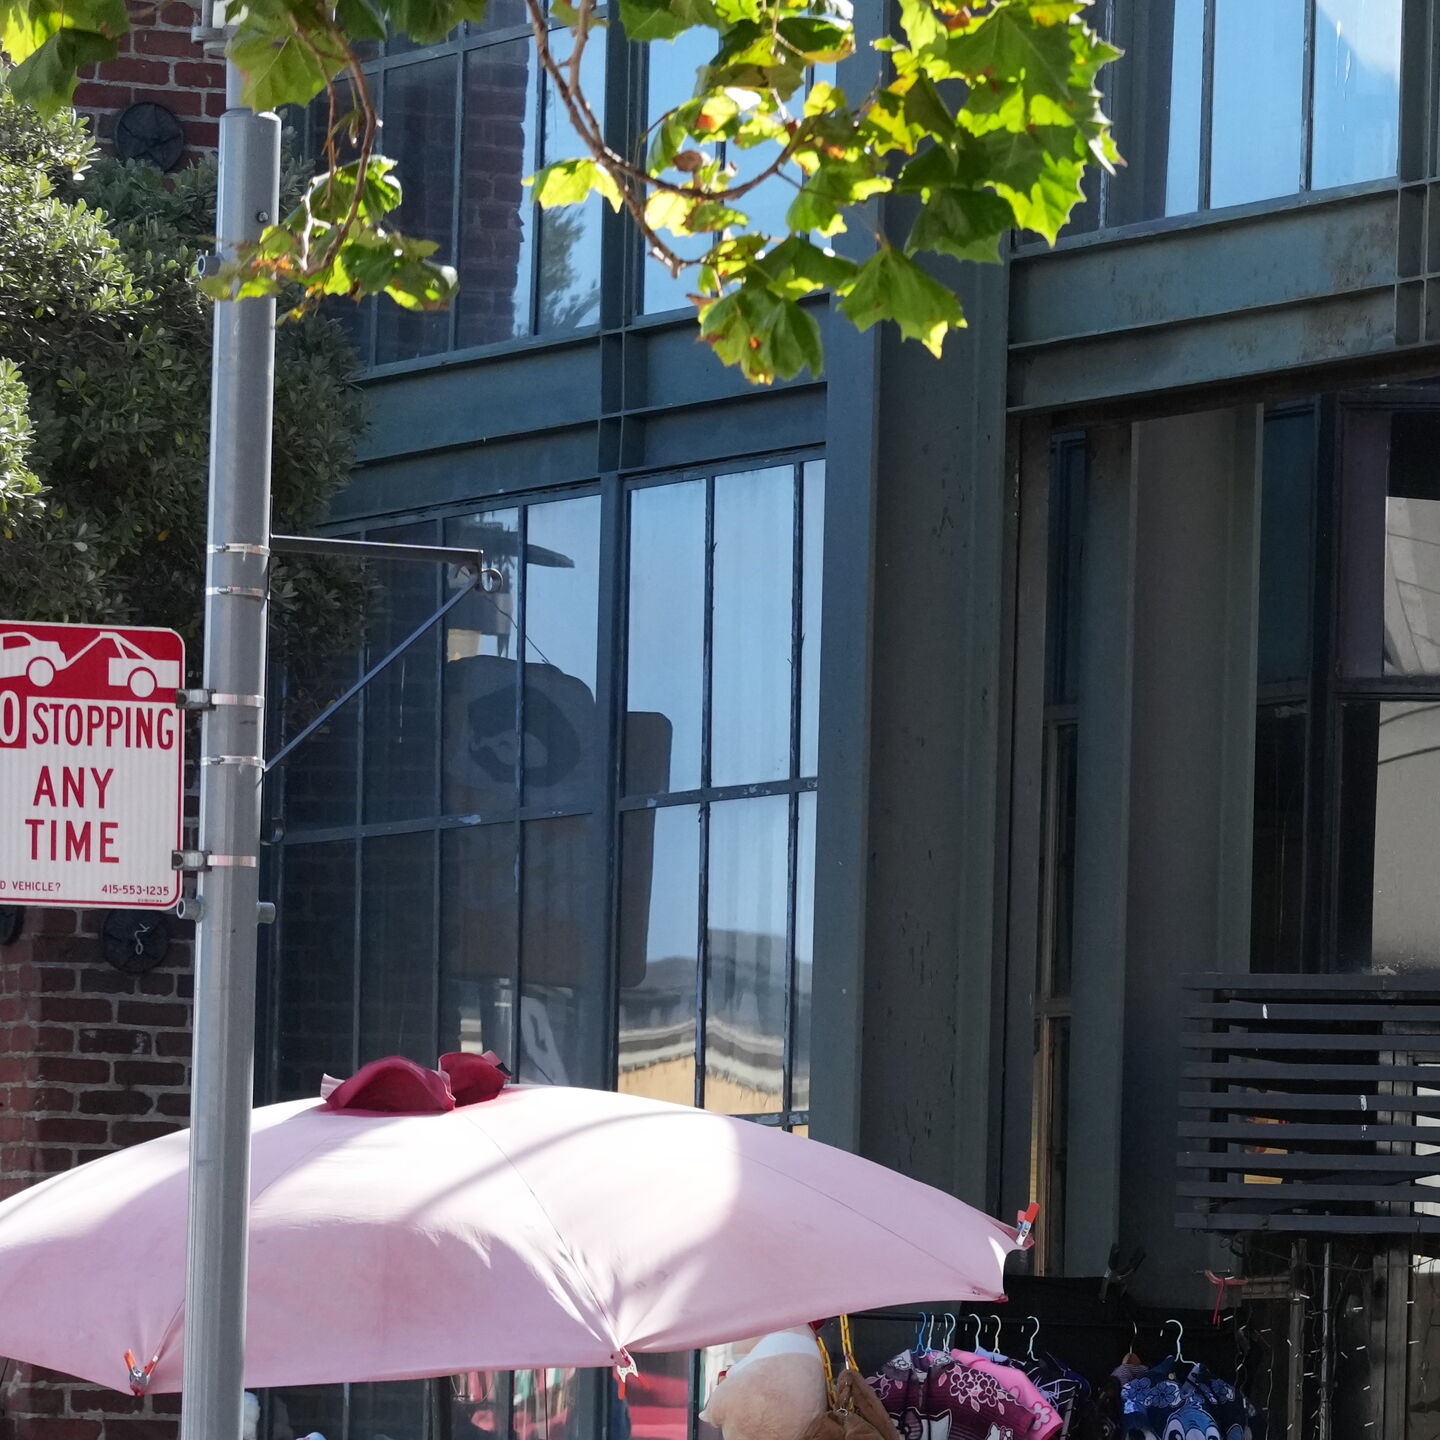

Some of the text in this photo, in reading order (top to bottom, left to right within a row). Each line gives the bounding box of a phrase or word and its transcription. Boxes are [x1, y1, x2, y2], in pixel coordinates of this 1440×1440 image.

[32, 703, 173, 750] STOPPING
[33, 765, 114, 809] ANY
[25, 819, 119, 863] TIME
[12, 881, 61, 892] VEHICLE?
[101, 884, 170, 896] 415-553-1235
